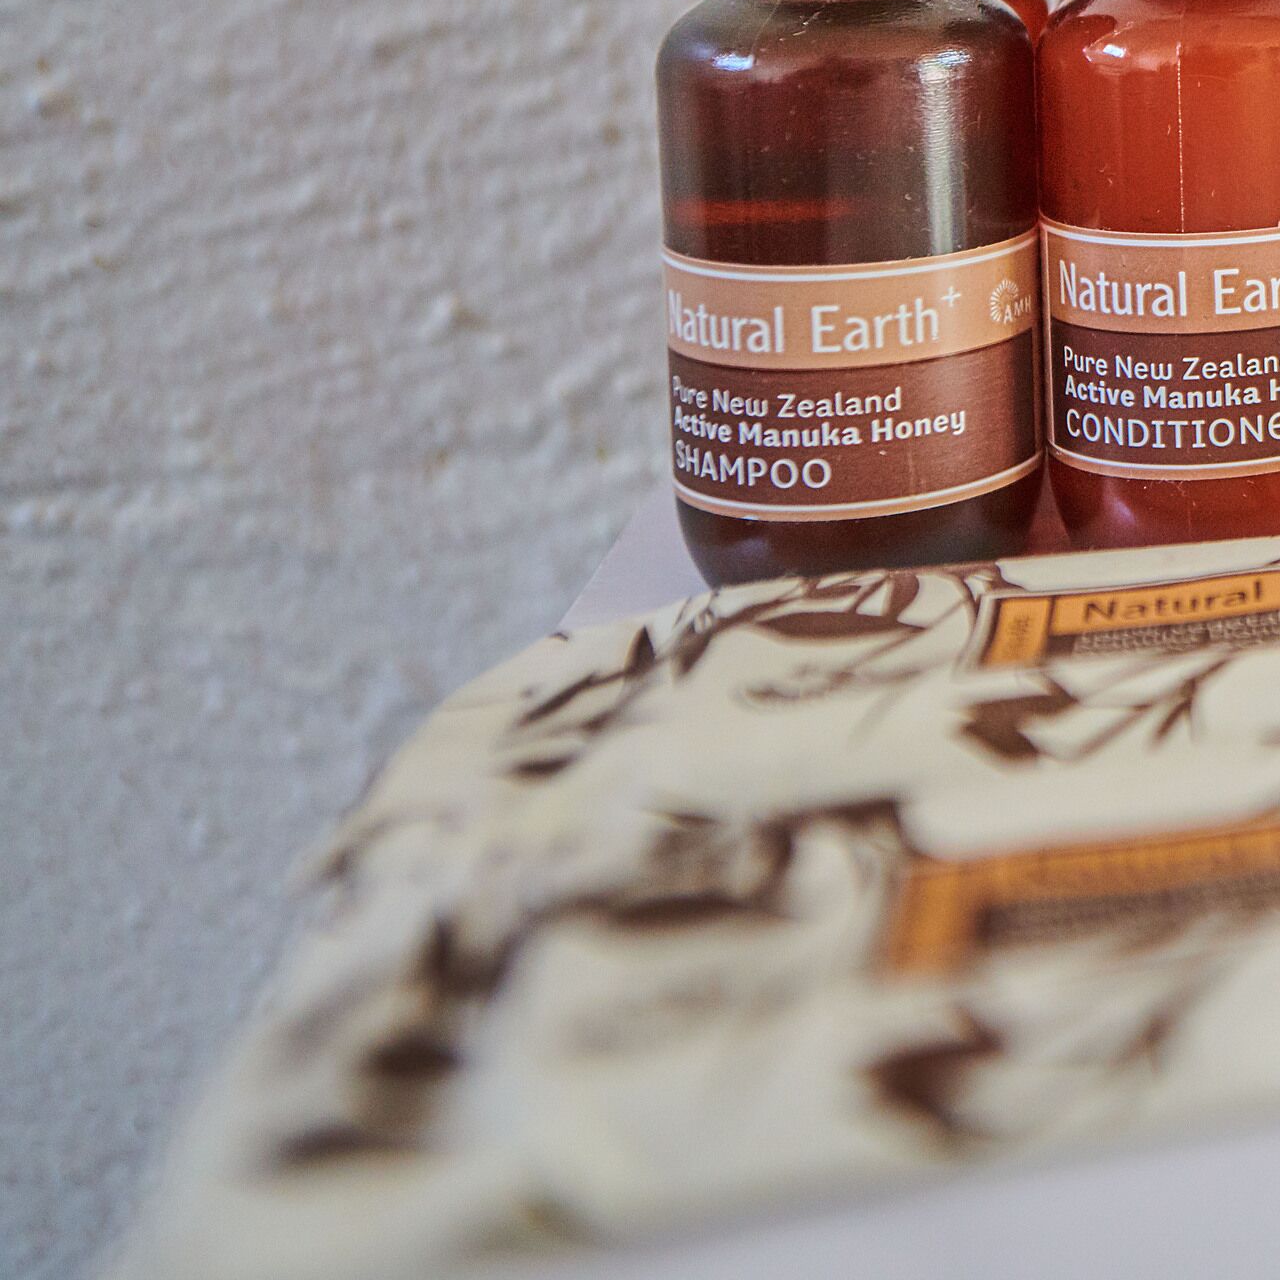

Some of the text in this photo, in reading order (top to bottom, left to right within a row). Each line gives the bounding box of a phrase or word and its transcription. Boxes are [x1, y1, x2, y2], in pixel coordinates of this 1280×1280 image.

[1059, 260, 1187, 317] Natural
[667, 289, 785, 353] Natural
[1063, 346, 1108, 377] Pure
[1115, 355, 1173, 381] New
[672, 375, 903, 419] Pure New Zealand
[1065, 374, 1136, 408] Active
[1143, 382, 1261, 410] Manuka
[674, 407, 966, 448] Active Manuka Honey
[675, 439, 833, 489] SHAMPOO
[1084, 577, 1264, 623] Natural
